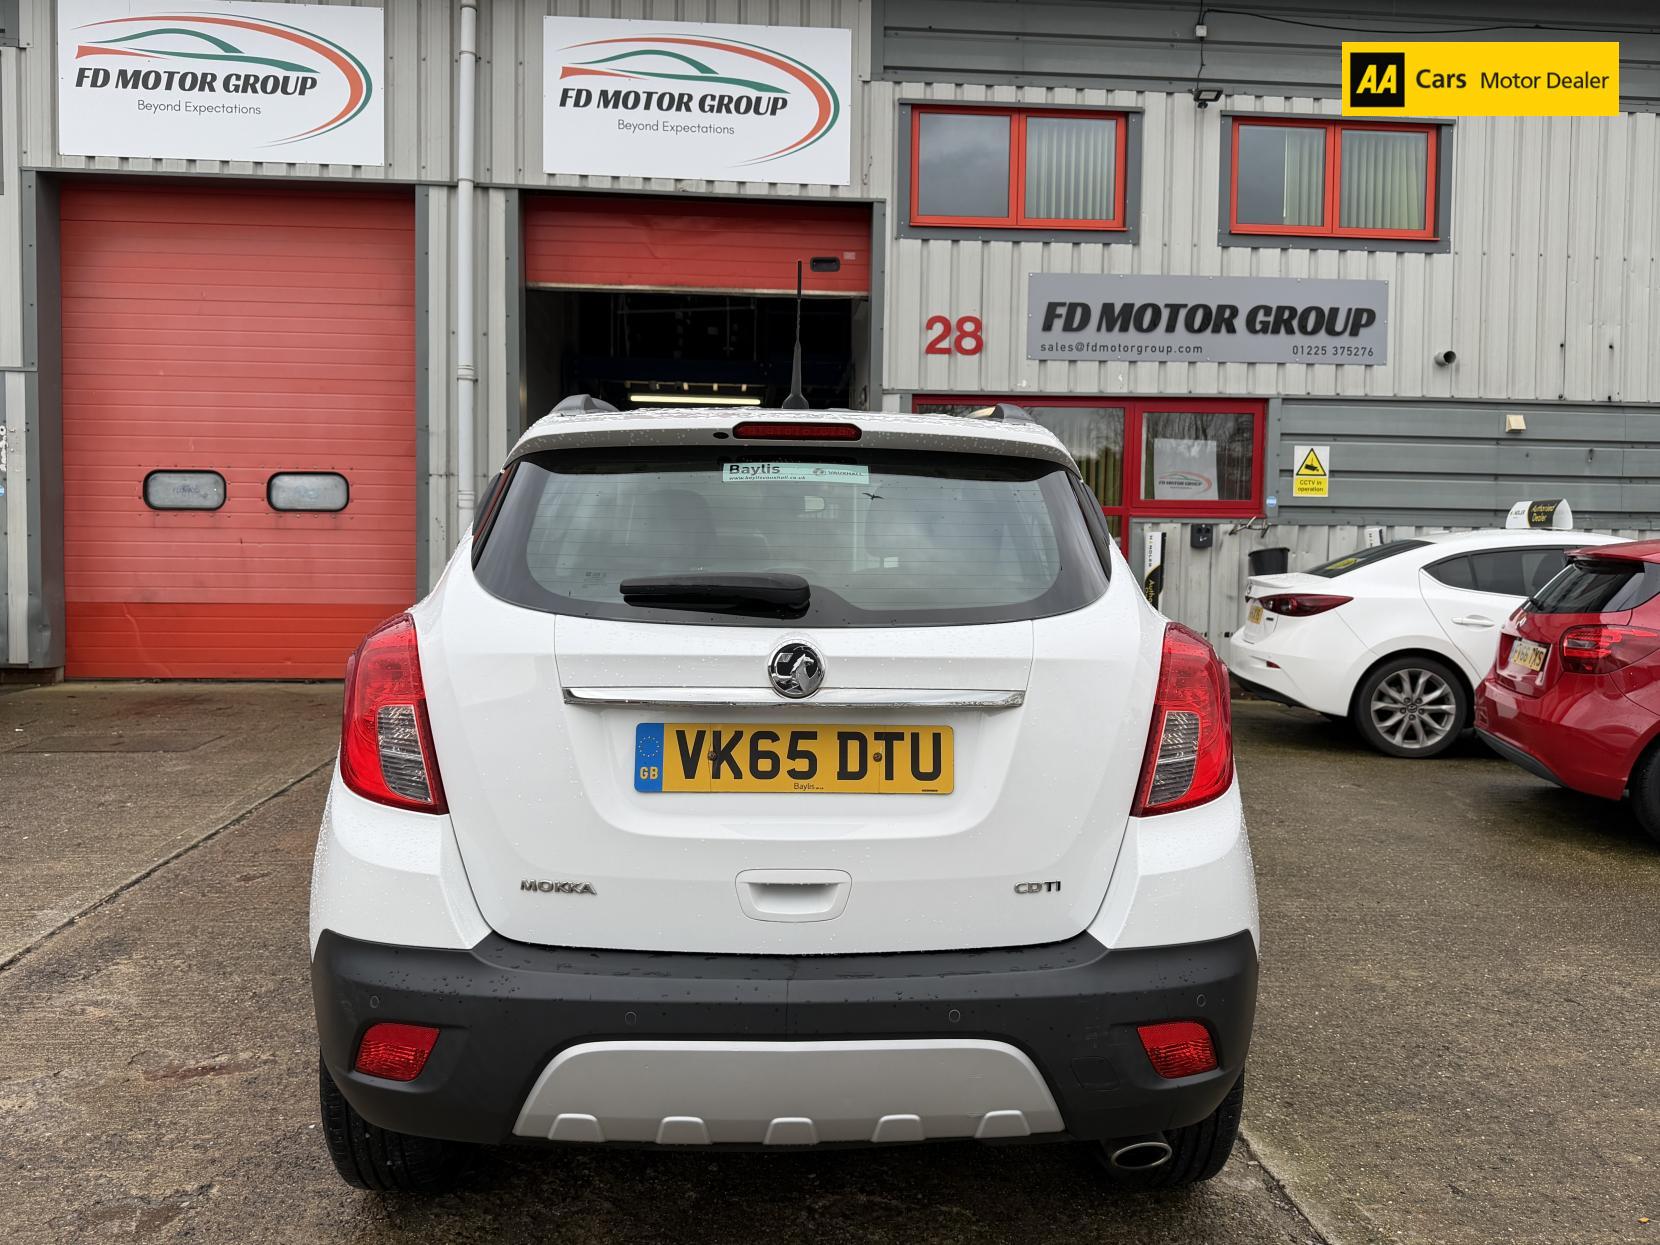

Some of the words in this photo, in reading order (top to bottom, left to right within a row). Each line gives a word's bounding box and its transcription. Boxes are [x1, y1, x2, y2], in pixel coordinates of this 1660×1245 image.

[75, 67, 111, 89] FD
[115, 69, 218, 93] MOTOR
[222, 73, 318, 96] GROUP
[137, 99, 181, 114] Beyond
[185, 101, 261, 116] Expectations
[559, 87, 593, 108] FD
[597, 89, 693, 113] MOTOR
[698, 93, 788, 116] GROUP
[617, 119, 659, 133] Beyond
[662, 120, 735, 135] Expectations
[1041, 301, 1092, 333] FD
[1096, 302, 1240, 335] MOTOR
[1245, 304, 1376, 337] GROUP
[925, 315, 984, 356] 28
[1040, 342, 1203, 356] sales@fdmotorgroup.com
[1292, 345, 1327, 356] 01225
[1332, 346, 1375, 357] 375276
[729, 464, 781, 476] Baylis
[675, 729, 818, 780] VK65
[836, 730, 942, 782] DTU
[640, 766, 659, 780] GB
[793, 782, 815, 791] Baylis
[520, 879, 598, 896] MOKKA
[1013, 880, 1061, 894] CDTI
